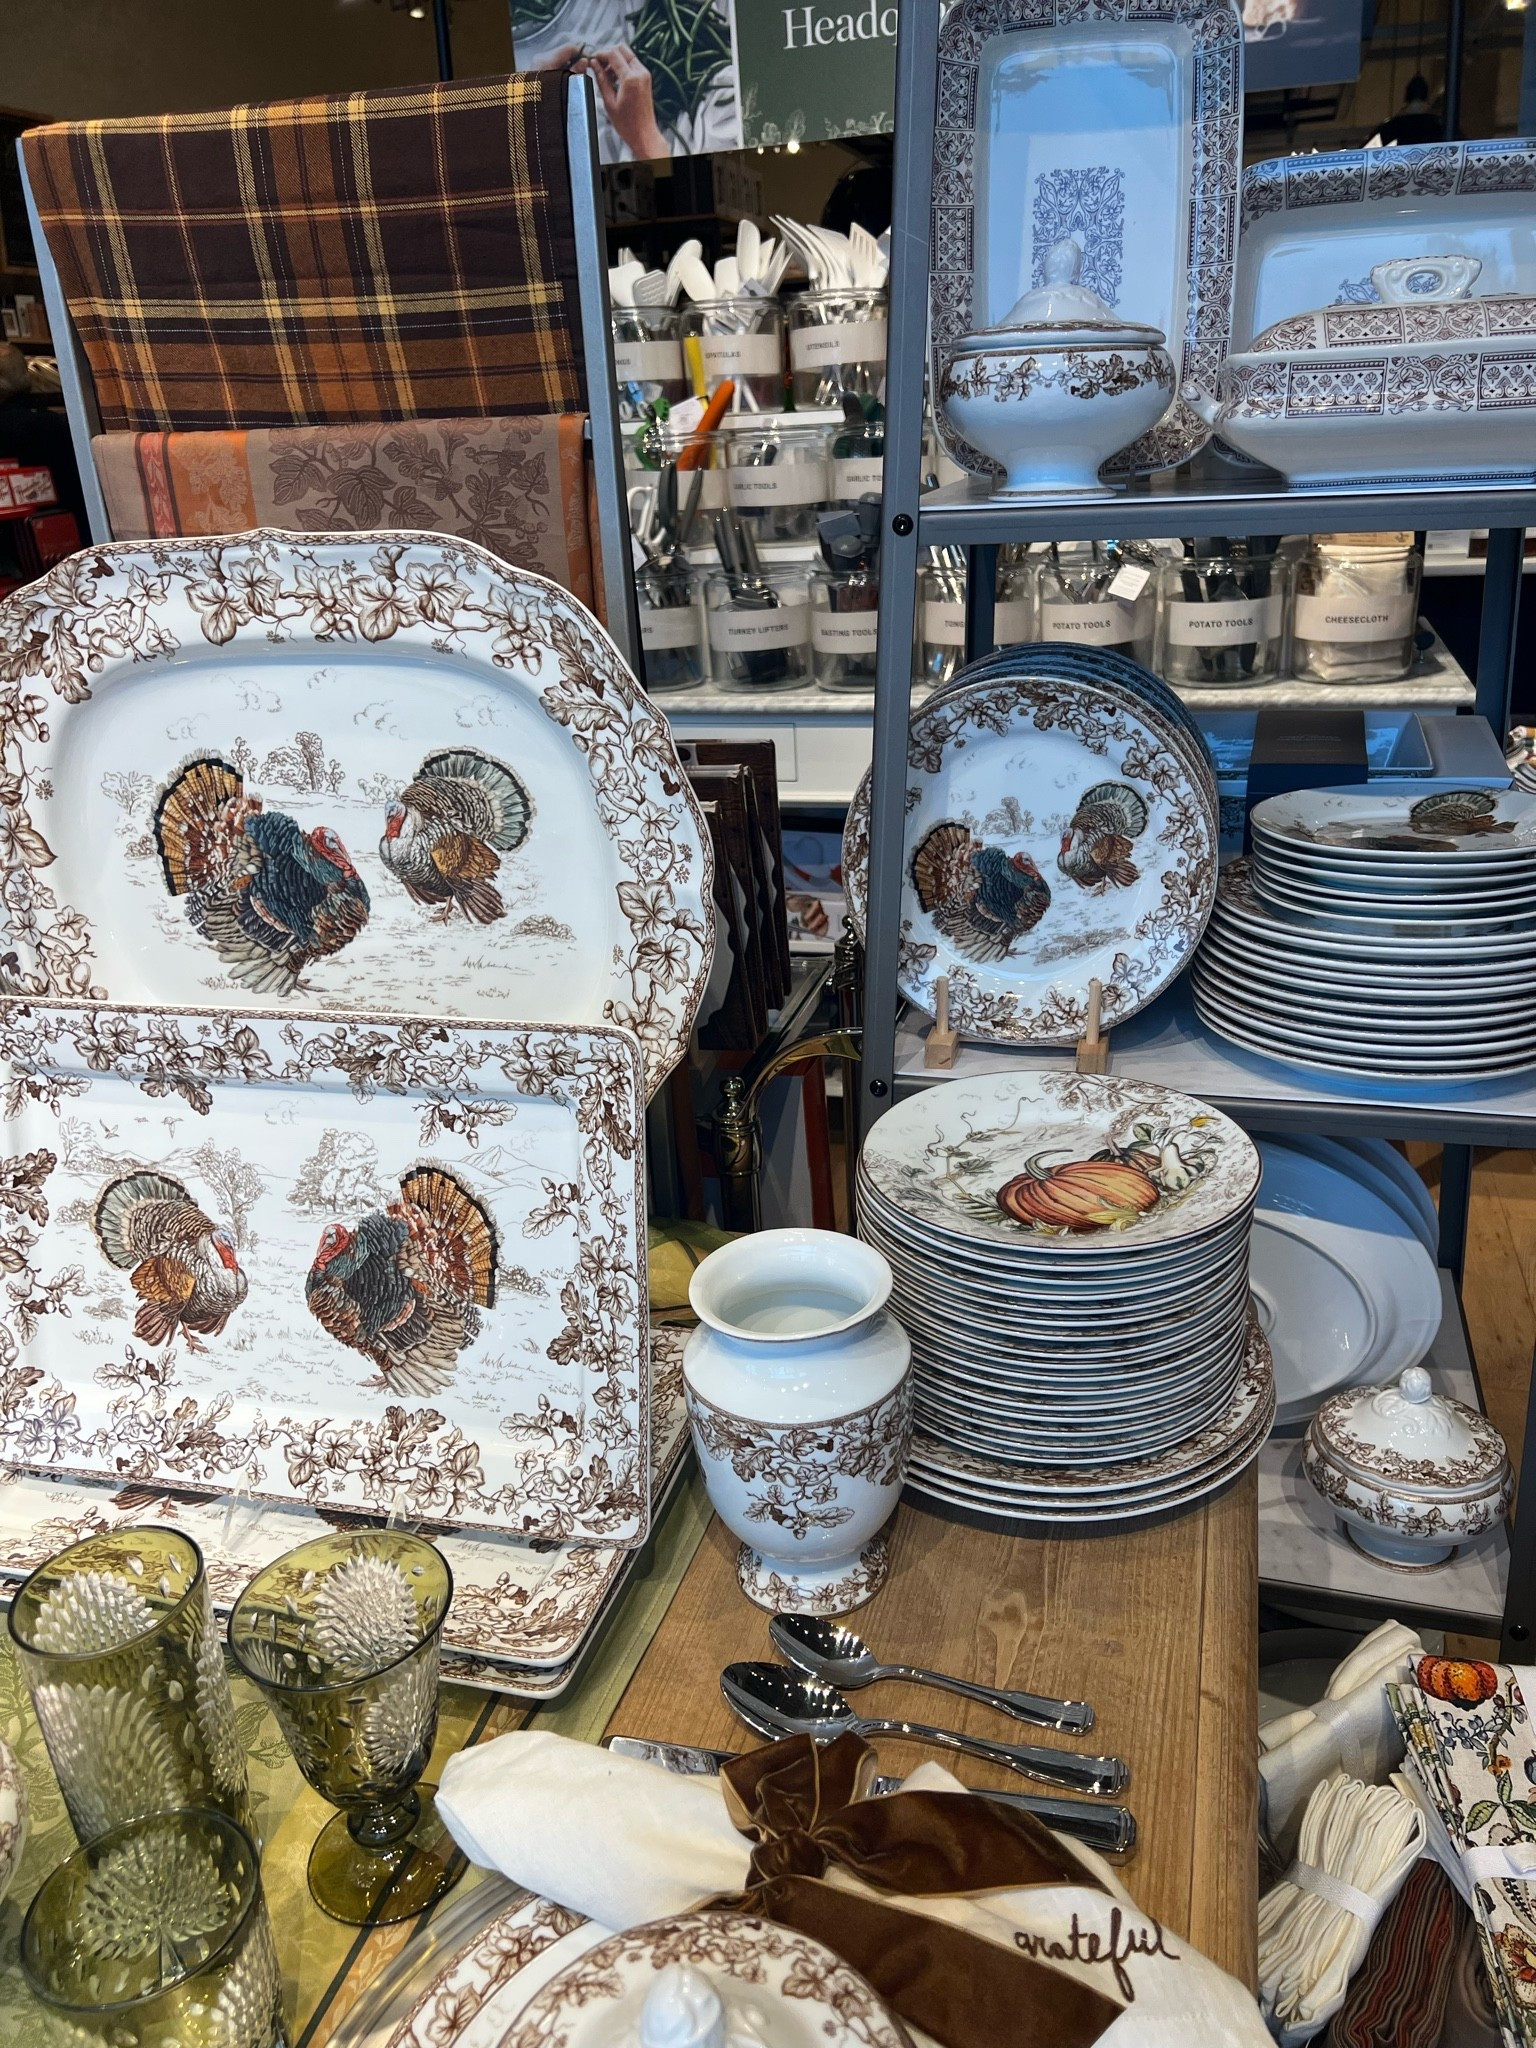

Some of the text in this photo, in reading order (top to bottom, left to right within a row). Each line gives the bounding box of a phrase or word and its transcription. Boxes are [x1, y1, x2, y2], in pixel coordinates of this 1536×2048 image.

[1189, 617, 1254, 629] POTATO TOOLS
[1324, 614, 1389, 624] CHEESECLOTH
[1052, 620, 1112, 630] POTATO TOOLS
[1014, 1907, 1181, 2003] grateful
